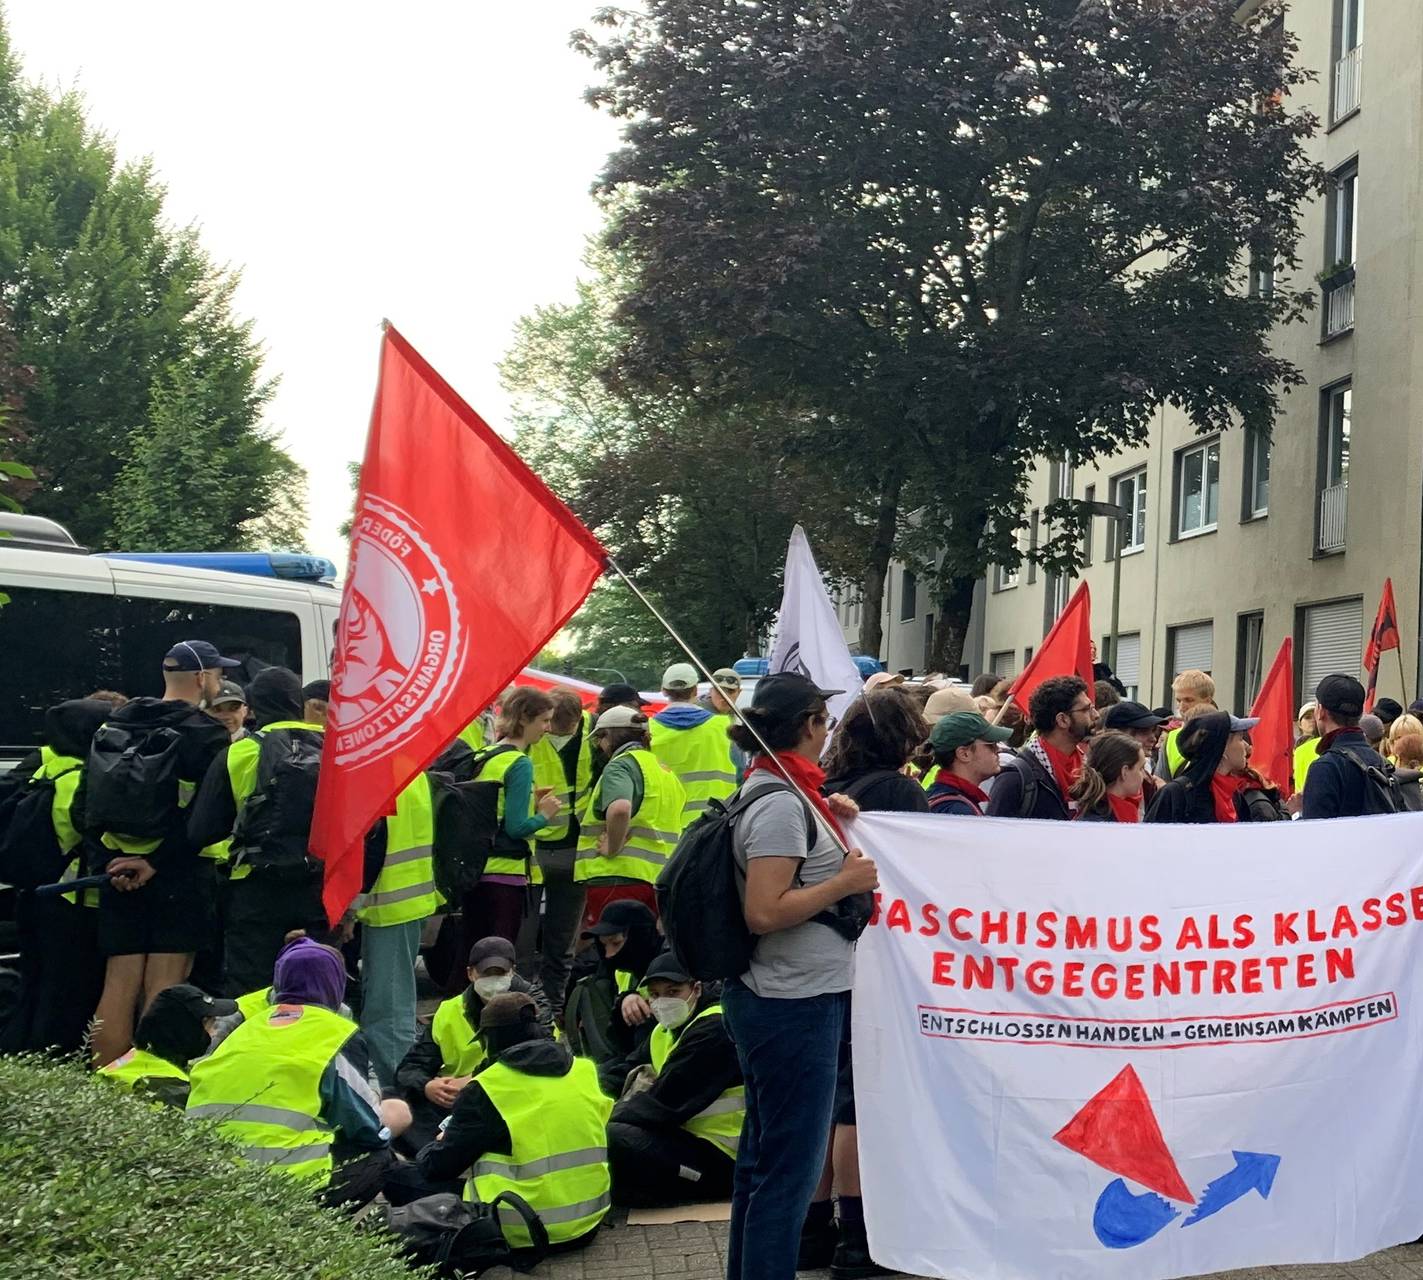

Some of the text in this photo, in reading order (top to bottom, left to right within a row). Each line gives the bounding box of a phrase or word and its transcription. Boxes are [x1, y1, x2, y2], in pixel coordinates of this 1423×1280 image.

[1175, 914, 1256, 950] ALS
[931, 948, 1356, 1000] ENTGEGENTRETEN
[921, 1013, 1071, 1039] ENTSCHLOSSEN
[1076, 1024, 1165, 1042] HANDELN
[1184, 1019, 1295, 1040] GEMEINSAM
[1298, 997, 1392, 1031] KÄMPFEN
